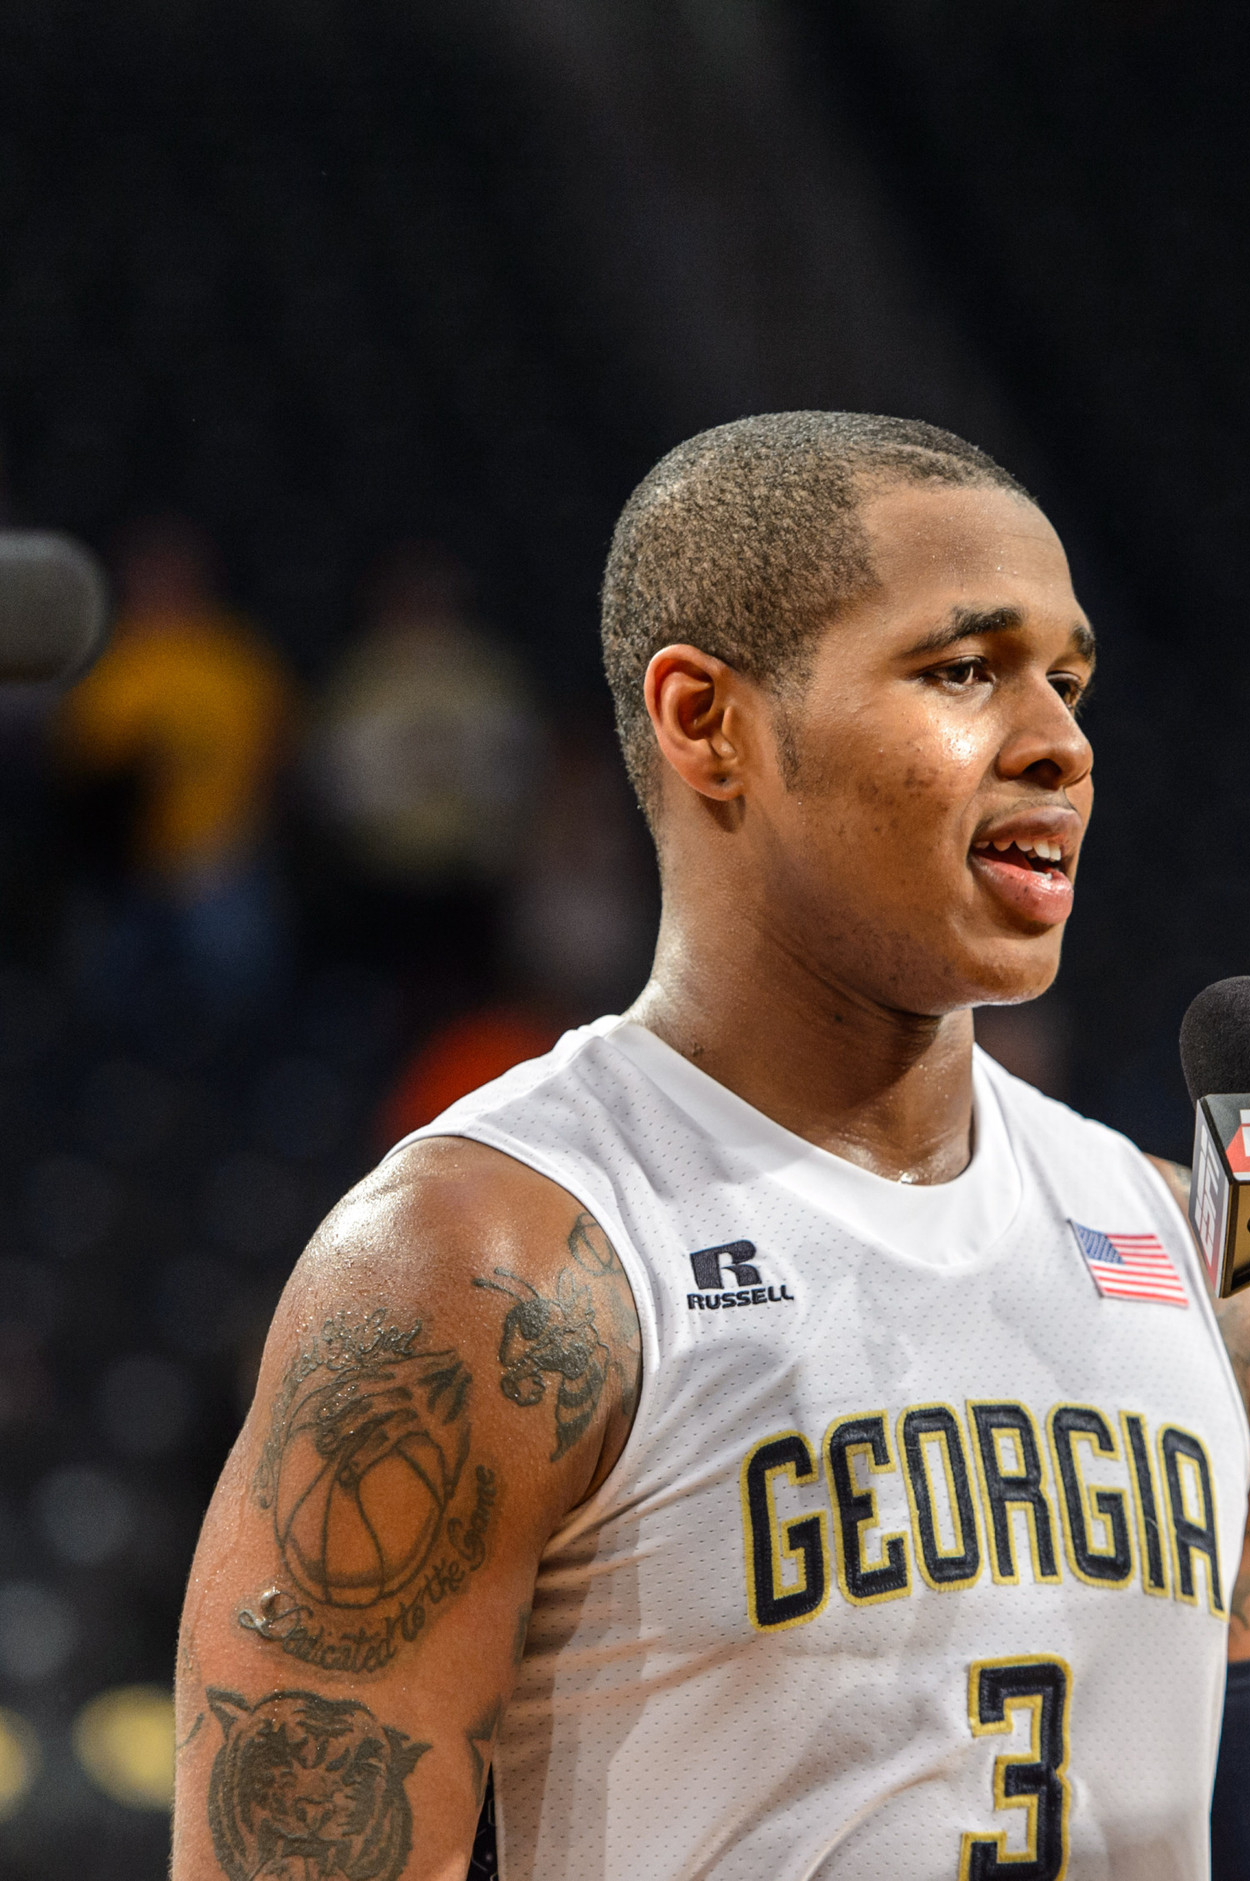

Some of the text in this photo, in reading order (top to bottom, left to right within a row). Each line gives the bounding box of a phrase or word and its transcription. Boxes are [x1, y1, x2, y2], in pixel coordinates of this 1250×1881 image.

[686, 1285, 794, 1310] RUSSELL
[423, 1559, 466, 1605] the
[740, 1400, 1229, 1633] GEORGIA
[958, 1653, 1073, 1881] 3
